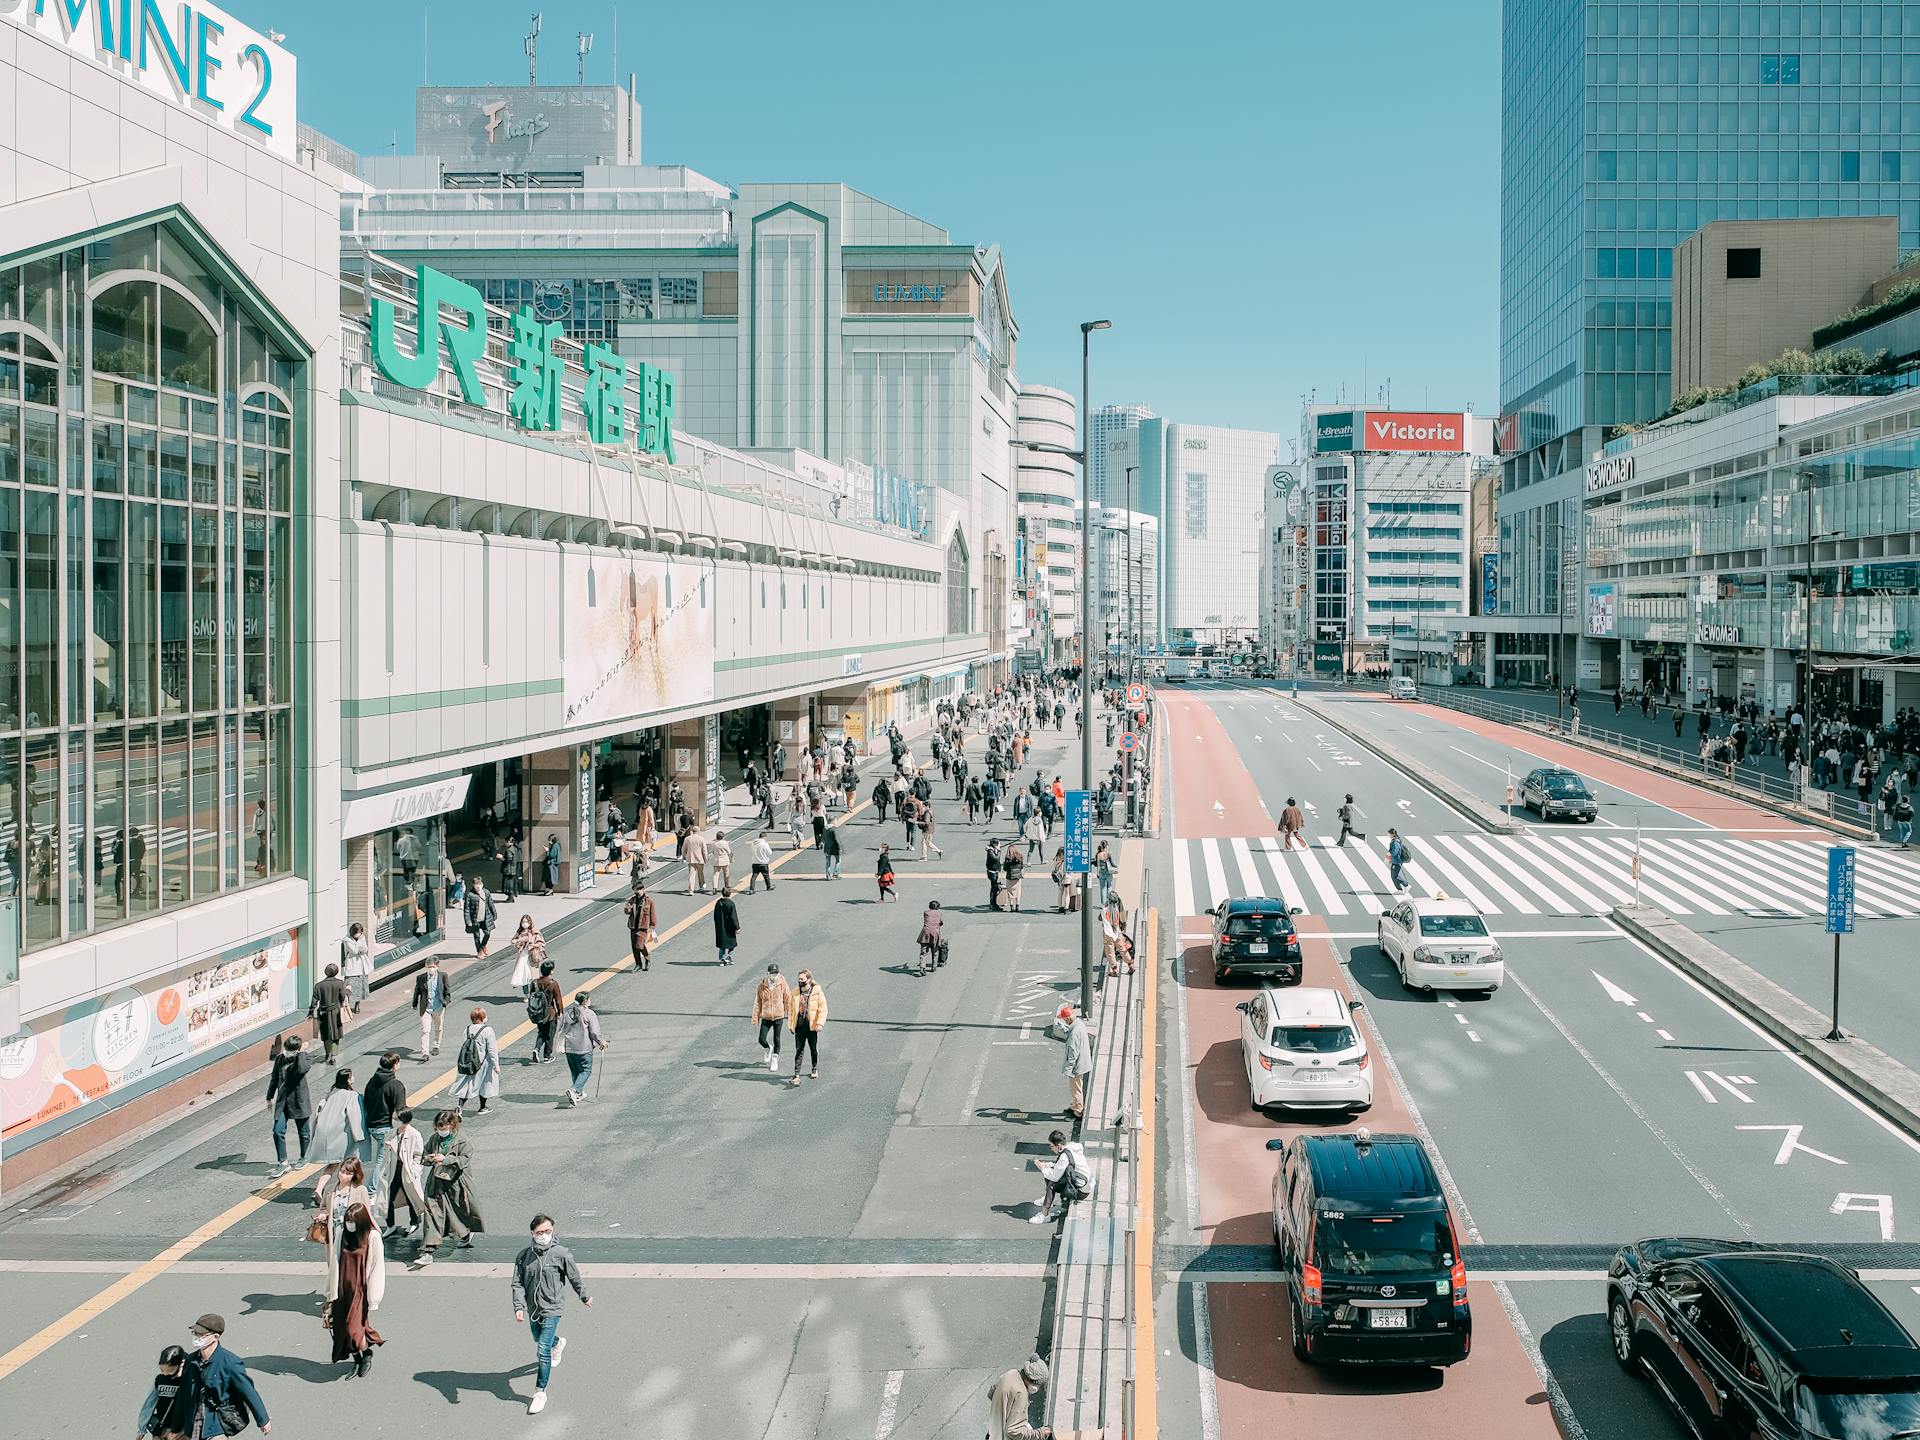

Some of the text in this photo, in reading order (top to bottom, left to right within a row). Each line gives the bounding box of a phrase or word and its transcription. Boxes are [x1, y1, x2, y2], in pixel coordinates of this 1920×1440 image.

[2, 0, 272, 144] MINE 2
[371, 265, 677, 464] JR新宿駅
[1373, 421, 1455, 441] Victoria
[391, 785, 455, 823] LUMINE 2
[1066, 835, 1074, 870] 入れません
[1829, 894, 1837, 931] 入れません
[123, 1067, 143, 1081] FLOOR
[1379, 1316, 1405, 1326] 58-62
